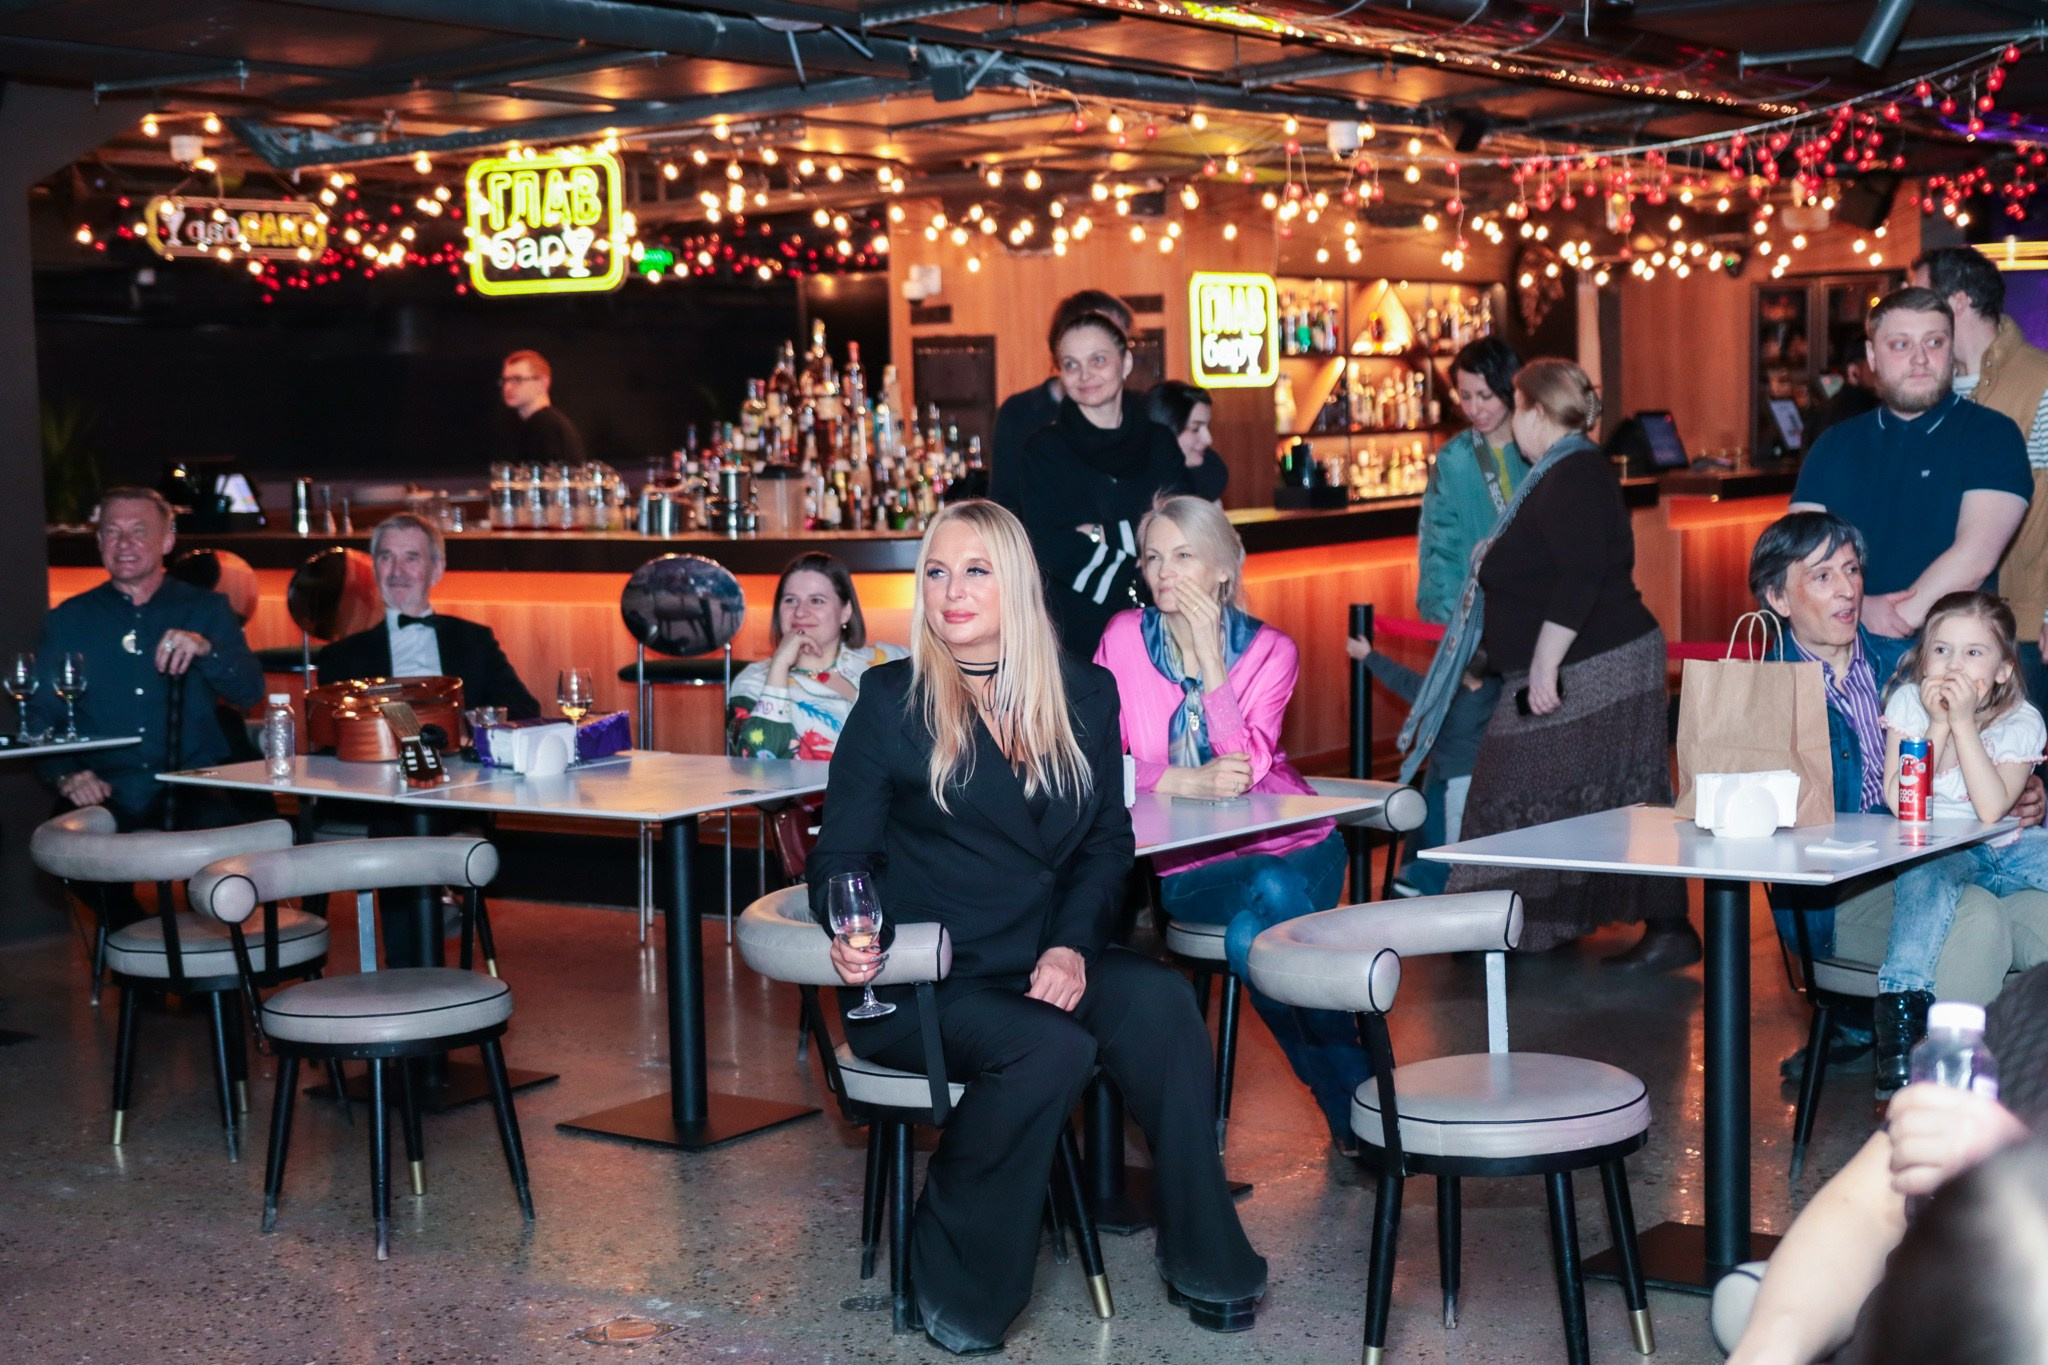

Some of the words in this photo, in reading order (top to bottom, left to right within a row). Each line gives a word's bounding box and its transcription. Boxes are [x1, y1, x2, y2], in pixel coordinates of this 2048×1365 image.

[487, 167, 602, 231] ГЛАВ
[491, 231, 566, 277] бар
[1201, 285, 1266, 335] ГЛАВ
[1203, 334, 1246, 373] бар
[1900, 789, 1917, 797] COOL
